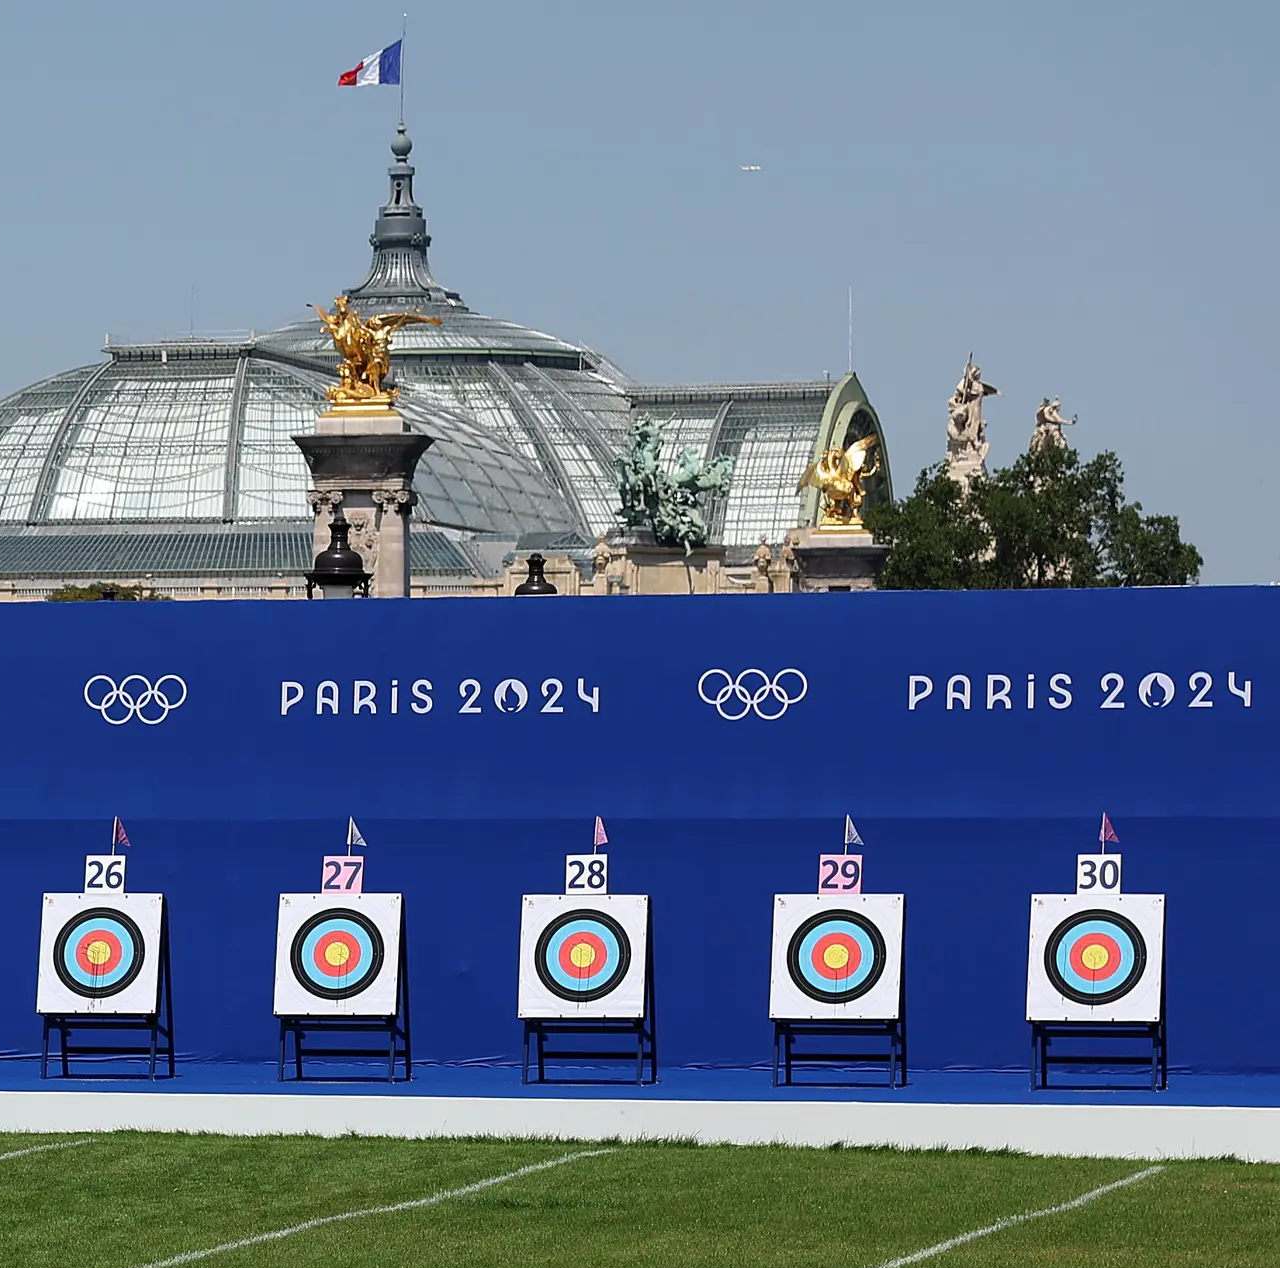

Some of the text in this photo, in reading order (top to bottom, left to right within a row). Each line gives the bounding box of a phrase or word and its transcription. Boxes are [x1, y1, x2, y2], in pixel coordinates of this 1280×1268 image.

[459, 678, 599, 713] 2024
[1100, 672, 1251, 708] 2024
[86, 860, 123, 889] 26
[323, 860, 363, 890] 27
[568, 859, 606, 889] 28
[820, 859, 860, 890] 29
[1078, 859, 1119, 890] 30
